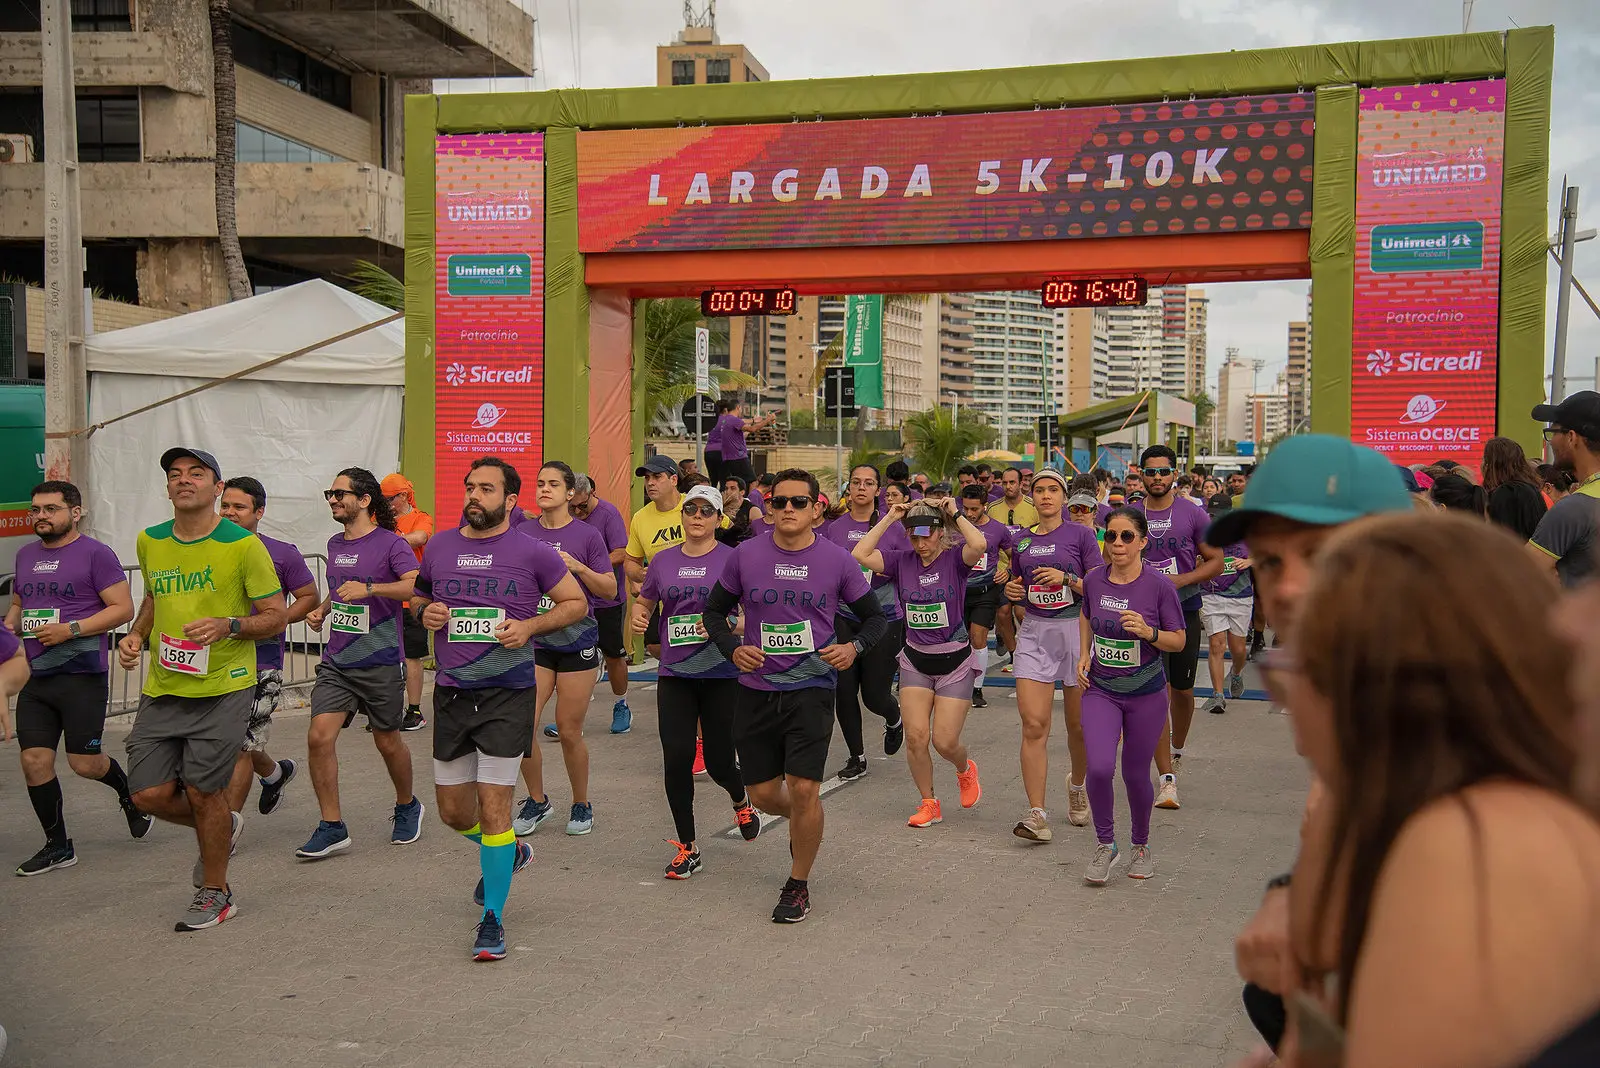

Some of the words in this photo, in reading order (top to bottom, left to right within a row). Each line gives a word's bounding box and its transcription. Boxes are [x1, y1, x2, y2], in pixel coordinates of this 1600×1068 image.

[1373, 164, 1487, 187] UNIMED
[648, 164, 932, 206] LARGADA
[448, 204, 532, 222] UNIMED
[1381, 235, 1446, 249] Unimed
[455, 265, 504, 276] Unimed
[1386, 309, 1464, 323] Patrocínio
[460, 329, 518, 341] Patrocínio
[852, 304, 864, 356] Unimed
[1397, 350, 1482, 372] Sicredi
[469, 365, 533, 383] Sicredi
[9, 517, 24, 527] 275
[149, 566, 180, 579] Unimed
[775, 569, 808, 577] UNIMED
[18, 582, 76, 597] ORRA
[749, 588, 828, 609] CORRA
[1036, 592, 1063, 604] 1699
[1100, 600, 1128, 609] UNIMED
[333, 612, 359, 627] 6278
[912, 612, 938, 623] 6109
[456, 620, 491, 634] 5013
[674, 624, 696, 638] 644
[768, 634, 802, 647] 6043
[164, 647, 196, 664] 1587
[1100, 647, 1130, 660] 5846
